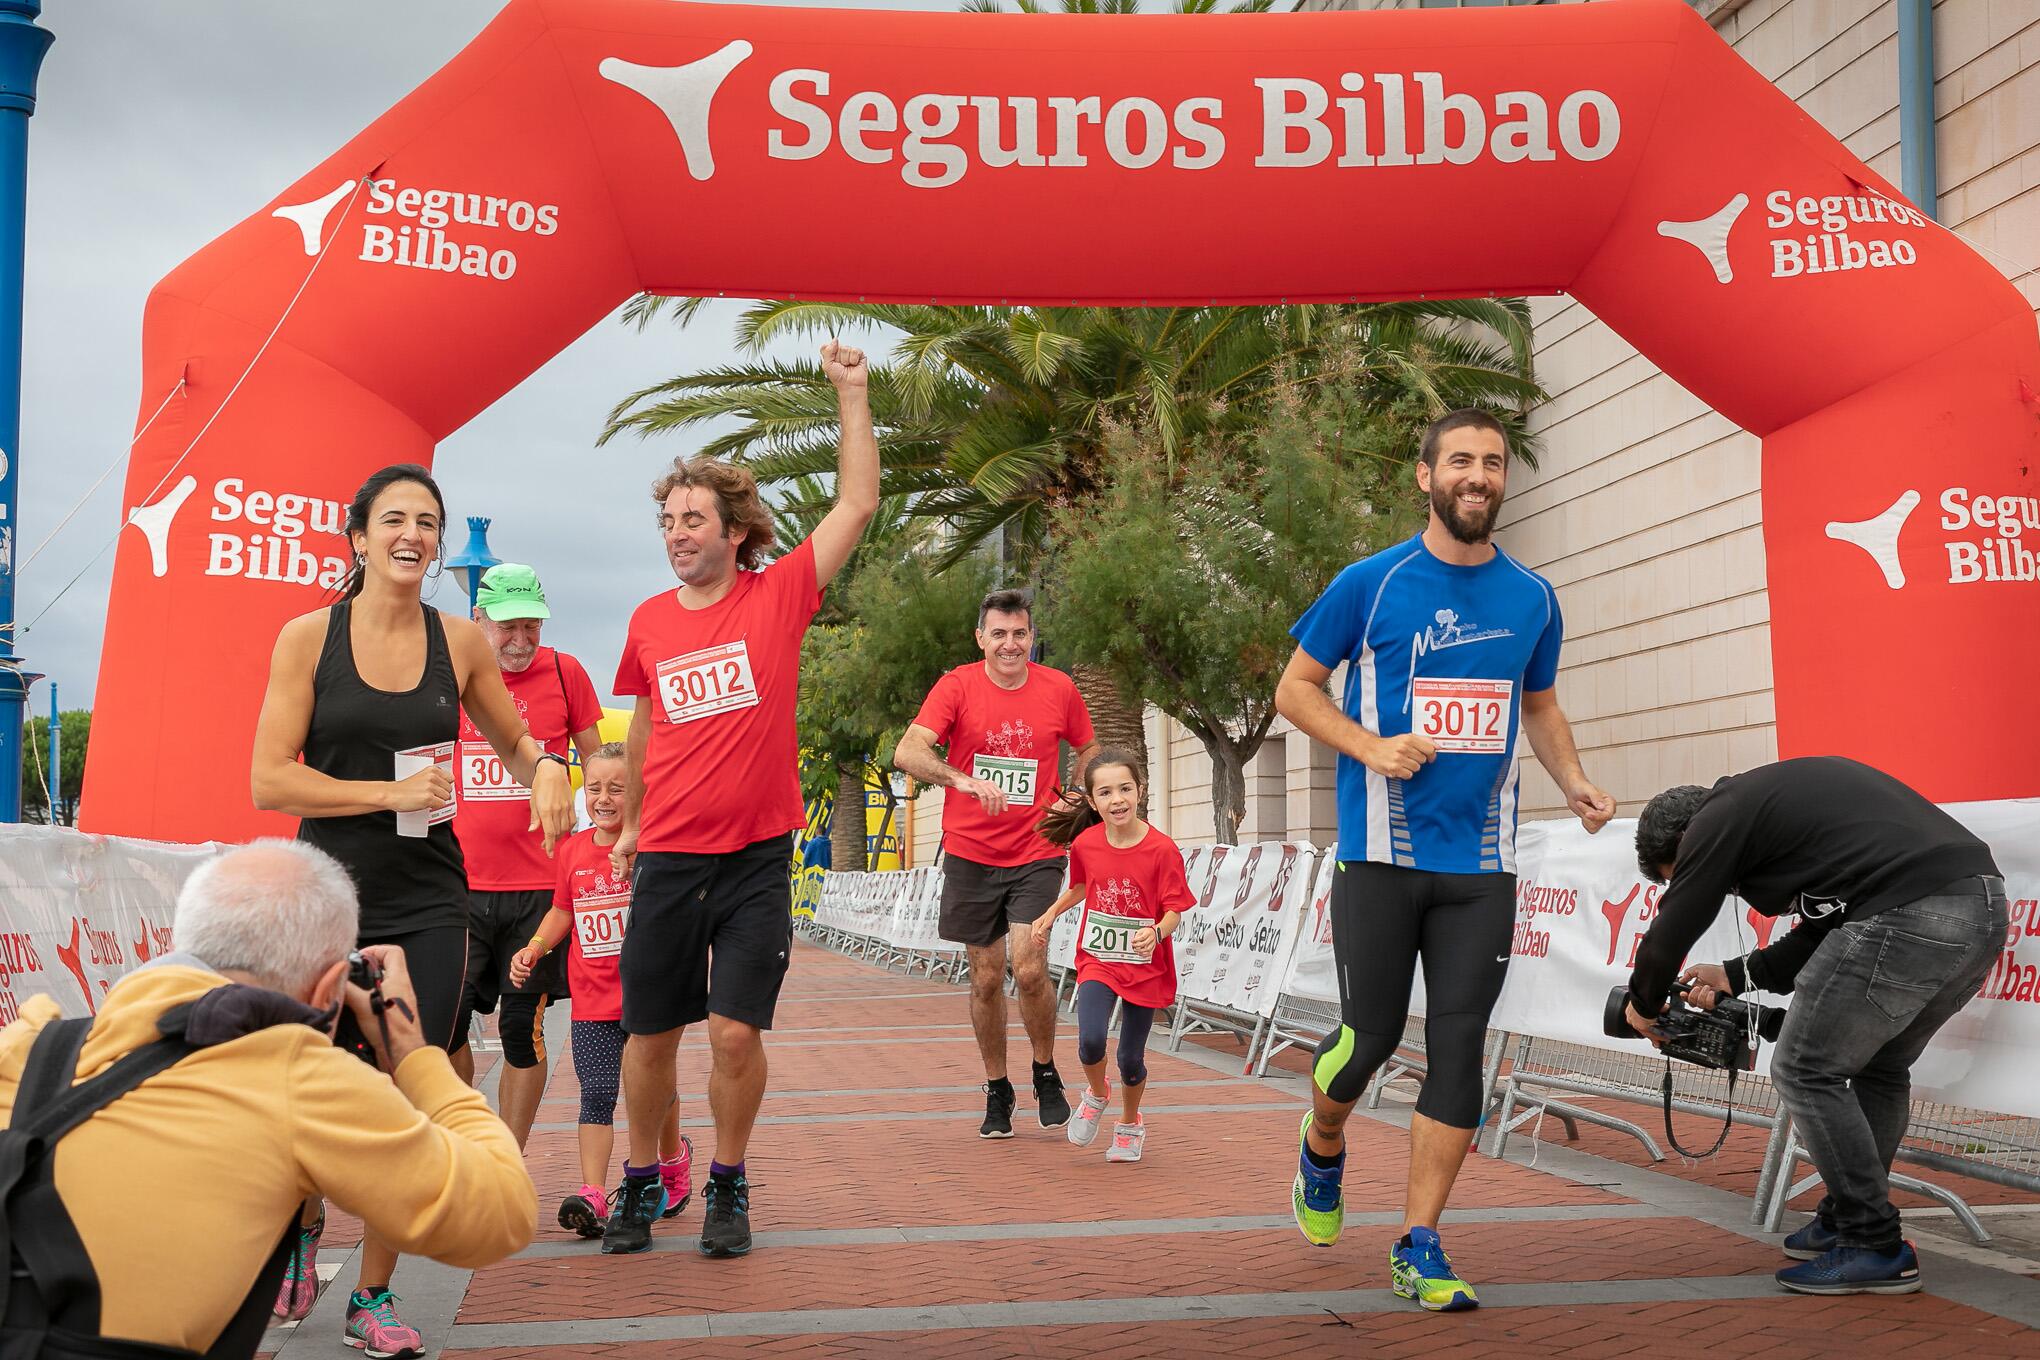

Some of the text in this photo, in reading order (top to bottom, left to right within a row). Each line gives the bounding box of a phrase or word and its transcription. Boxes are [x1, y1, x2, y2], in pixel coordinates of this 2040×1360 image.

[767, 68, 1622, 189] Seguros Bilbao
[366, 178, 560, 236] Seguros
[358, 224, 518, 281] Bilbao
[1769, 232, 1918, 278] Bilbao
[210, 478, 352, 538] Segu
[204, 533, 354, 592] Bilba
[669, 661, 745, 707] 3012
[1423, 700, 1501, 737] 3012
[471, 757, 517, 786] 30
[1518, 879, 1578, 920] Seguros
[582, 910, 626, 943] 301
[1088, 925, 1139, 951] 201
[1249, 916, 1281, 955] Getxo
